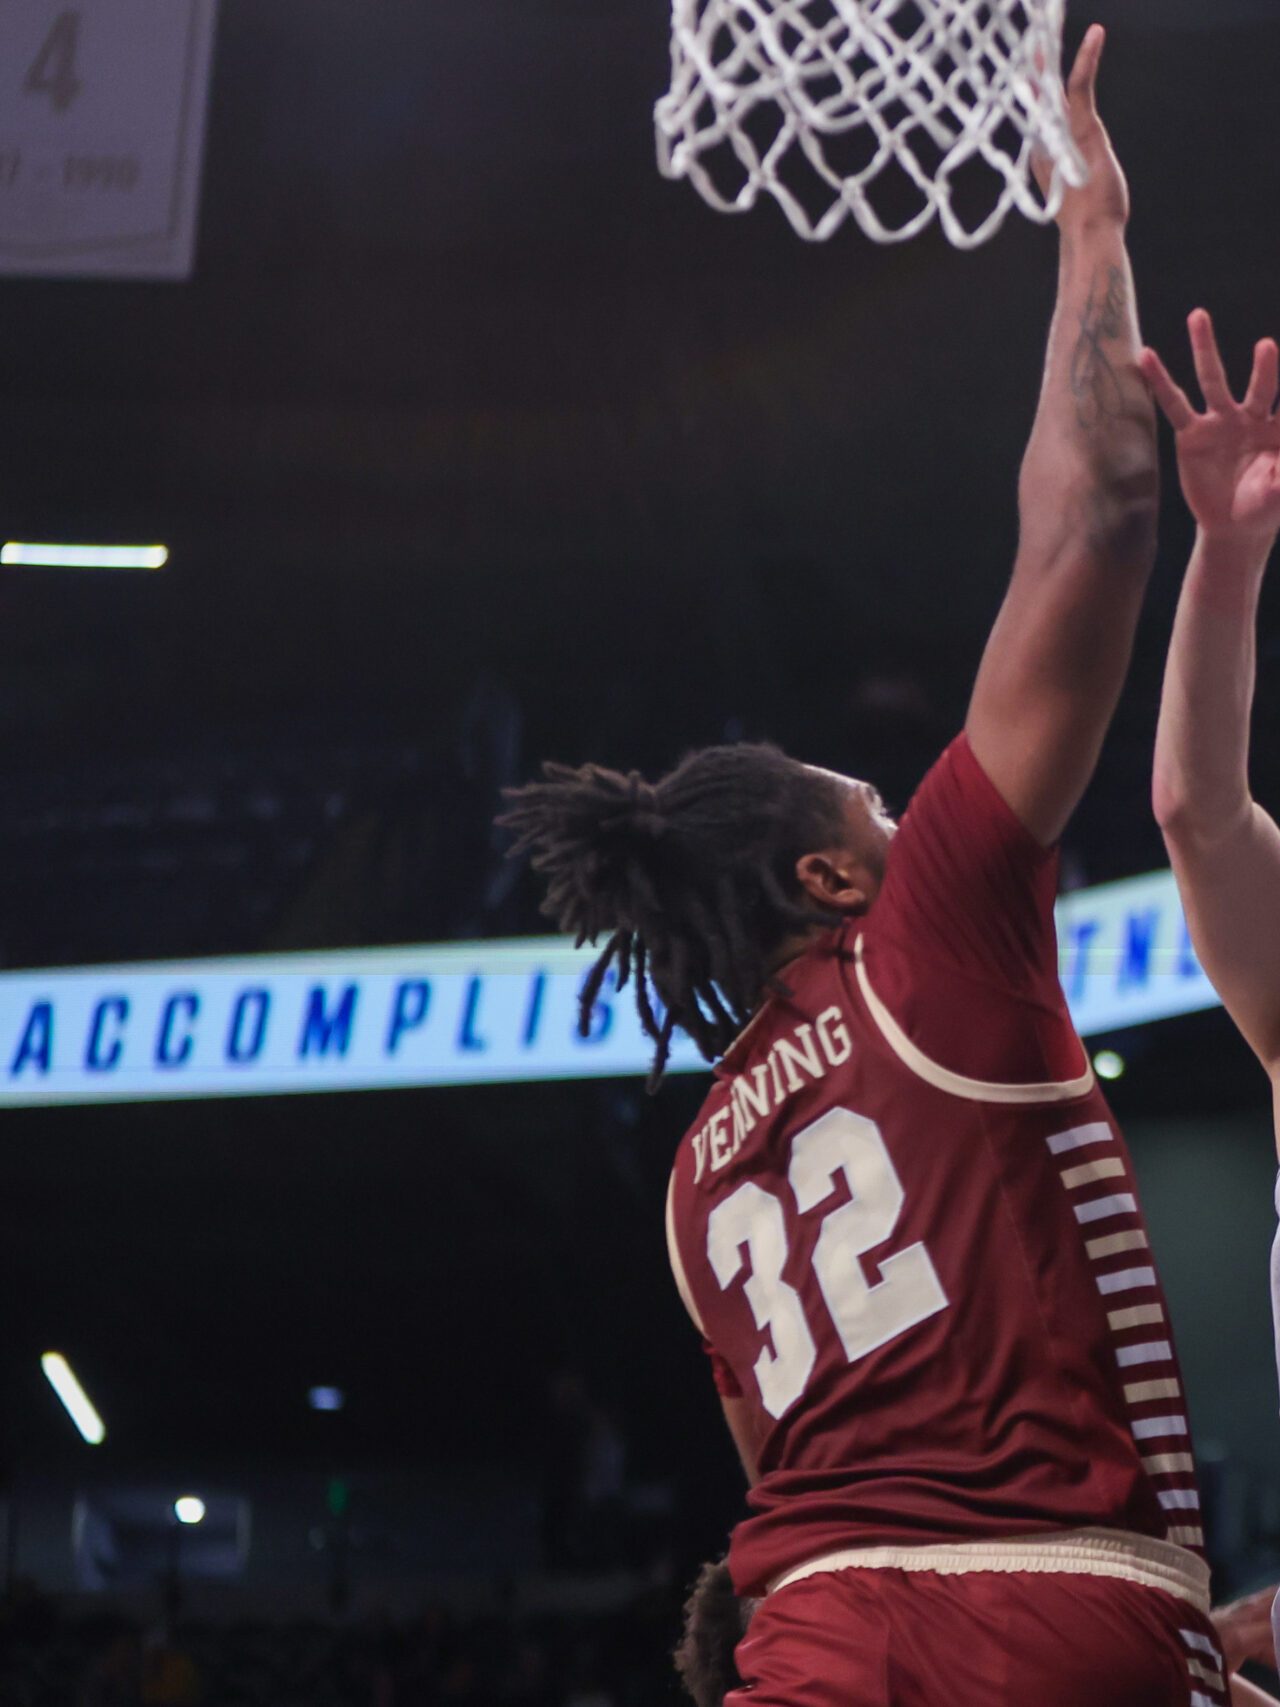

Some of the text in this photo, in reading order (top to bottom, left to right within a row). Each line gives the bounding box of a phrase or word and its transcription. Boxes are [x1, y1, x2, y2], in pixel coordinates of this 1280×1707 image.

[22, 8, 83, 115] 4
[8, 964, 668, 1080] ACCOMPLIS
[706, 1106, 949, 1420] 32
